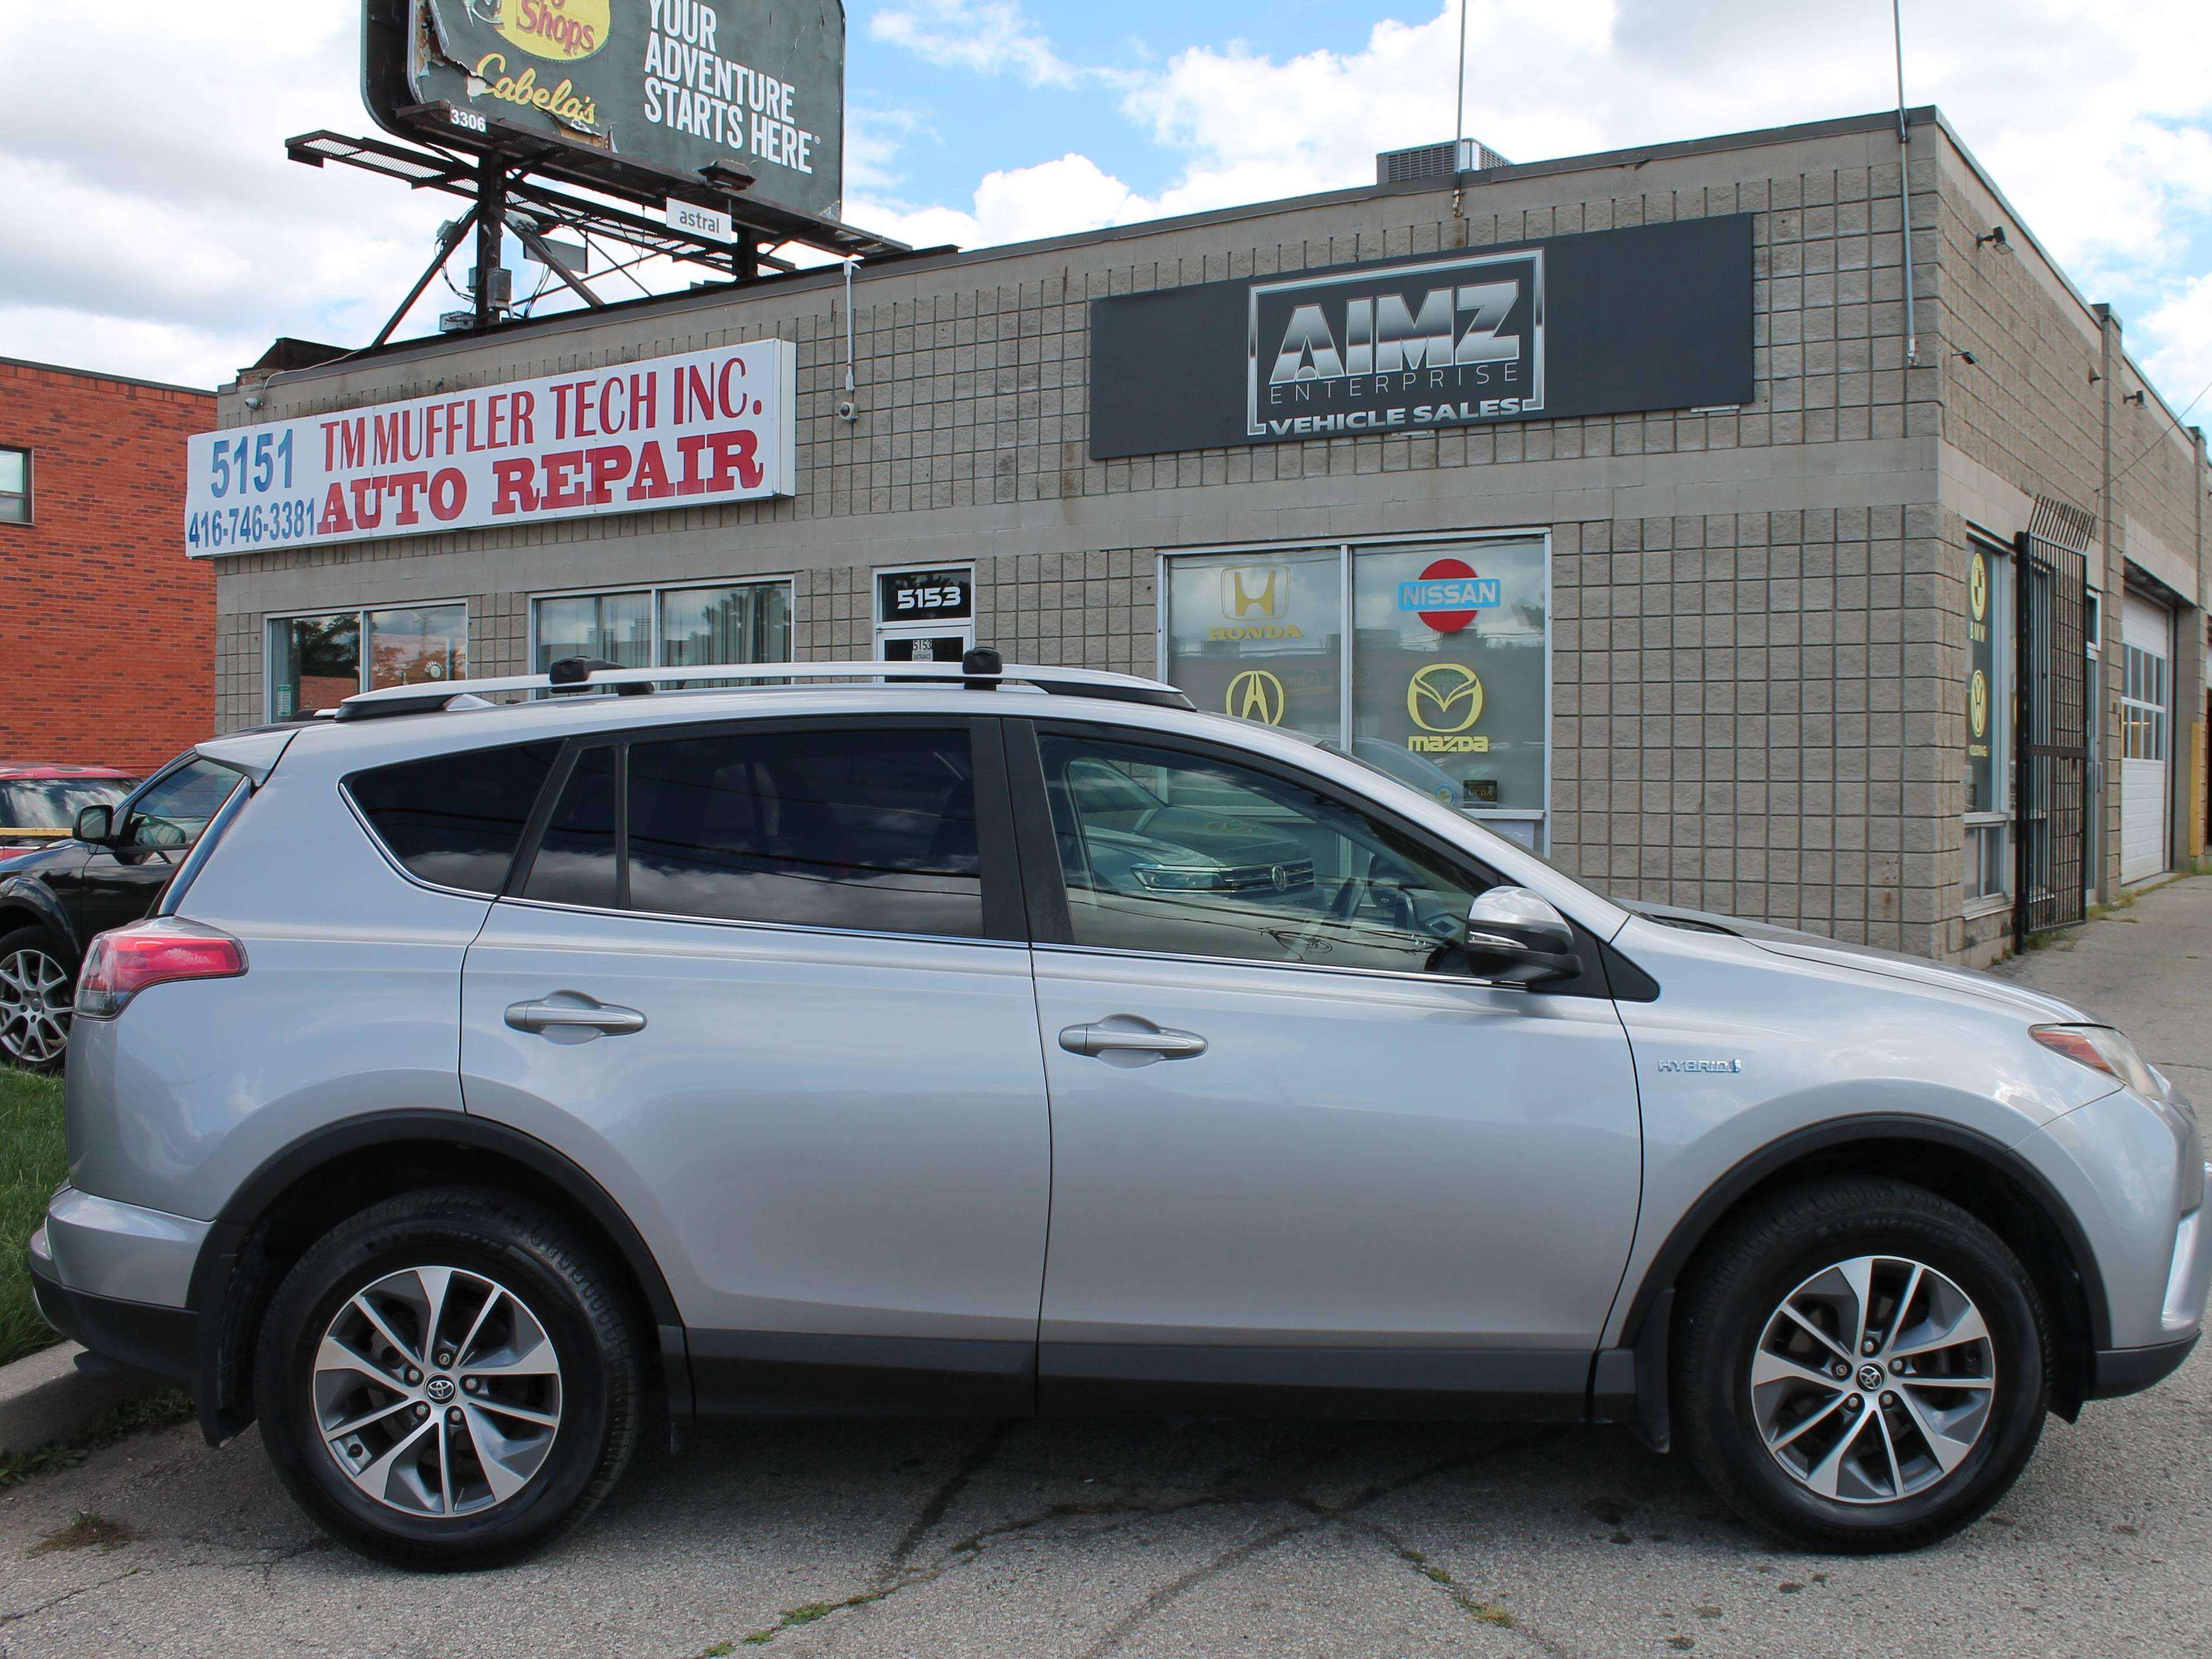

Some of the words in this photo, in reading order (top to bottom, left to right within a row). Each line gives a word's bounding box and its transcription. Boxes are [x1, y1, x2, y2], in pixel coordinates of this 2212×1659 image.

[516, 0, 595, 56] Shops
[649, 0, 717, 52] YOUR
[473, 52, 596, 125] Cabela's
[644, 31, 795, 125] ADVENTURE
[451, 109, 485, 132] 3306
[644, 77, 743, 149] STARTS
[679, 211, 720, 234] astral
[1269, 279, 1519, 385] AIMZ
[1271, 362, 1518, 404] ENTERPRISE
[320, 417, 365, 472] TM
[373, 390, 535, 466] MUFFLER
[549, 371, 657, 440] TECH
[674, 357, 762, 425] INC.
[1268, 407, 1405, 436] VEHICLE
[1413, 397, 1521, 422] SALES
[210, 429, 293, 498] 5151
[317, 467, 467, 535] AUTO
[492, 429, 763, 516] REPAIR
[189, 498, 315, 549] 416-746-3381
[897, 586, 961, 609] 5153
[1403, 582, 1496, 606] NISSAN
[913, 640, 932, 651] 5153
[1208, 625, 1304, 641] HONDA
[1969, 621, 1985, 643] BMW
[1658, 1058, 1728, 1072] HYBRID
